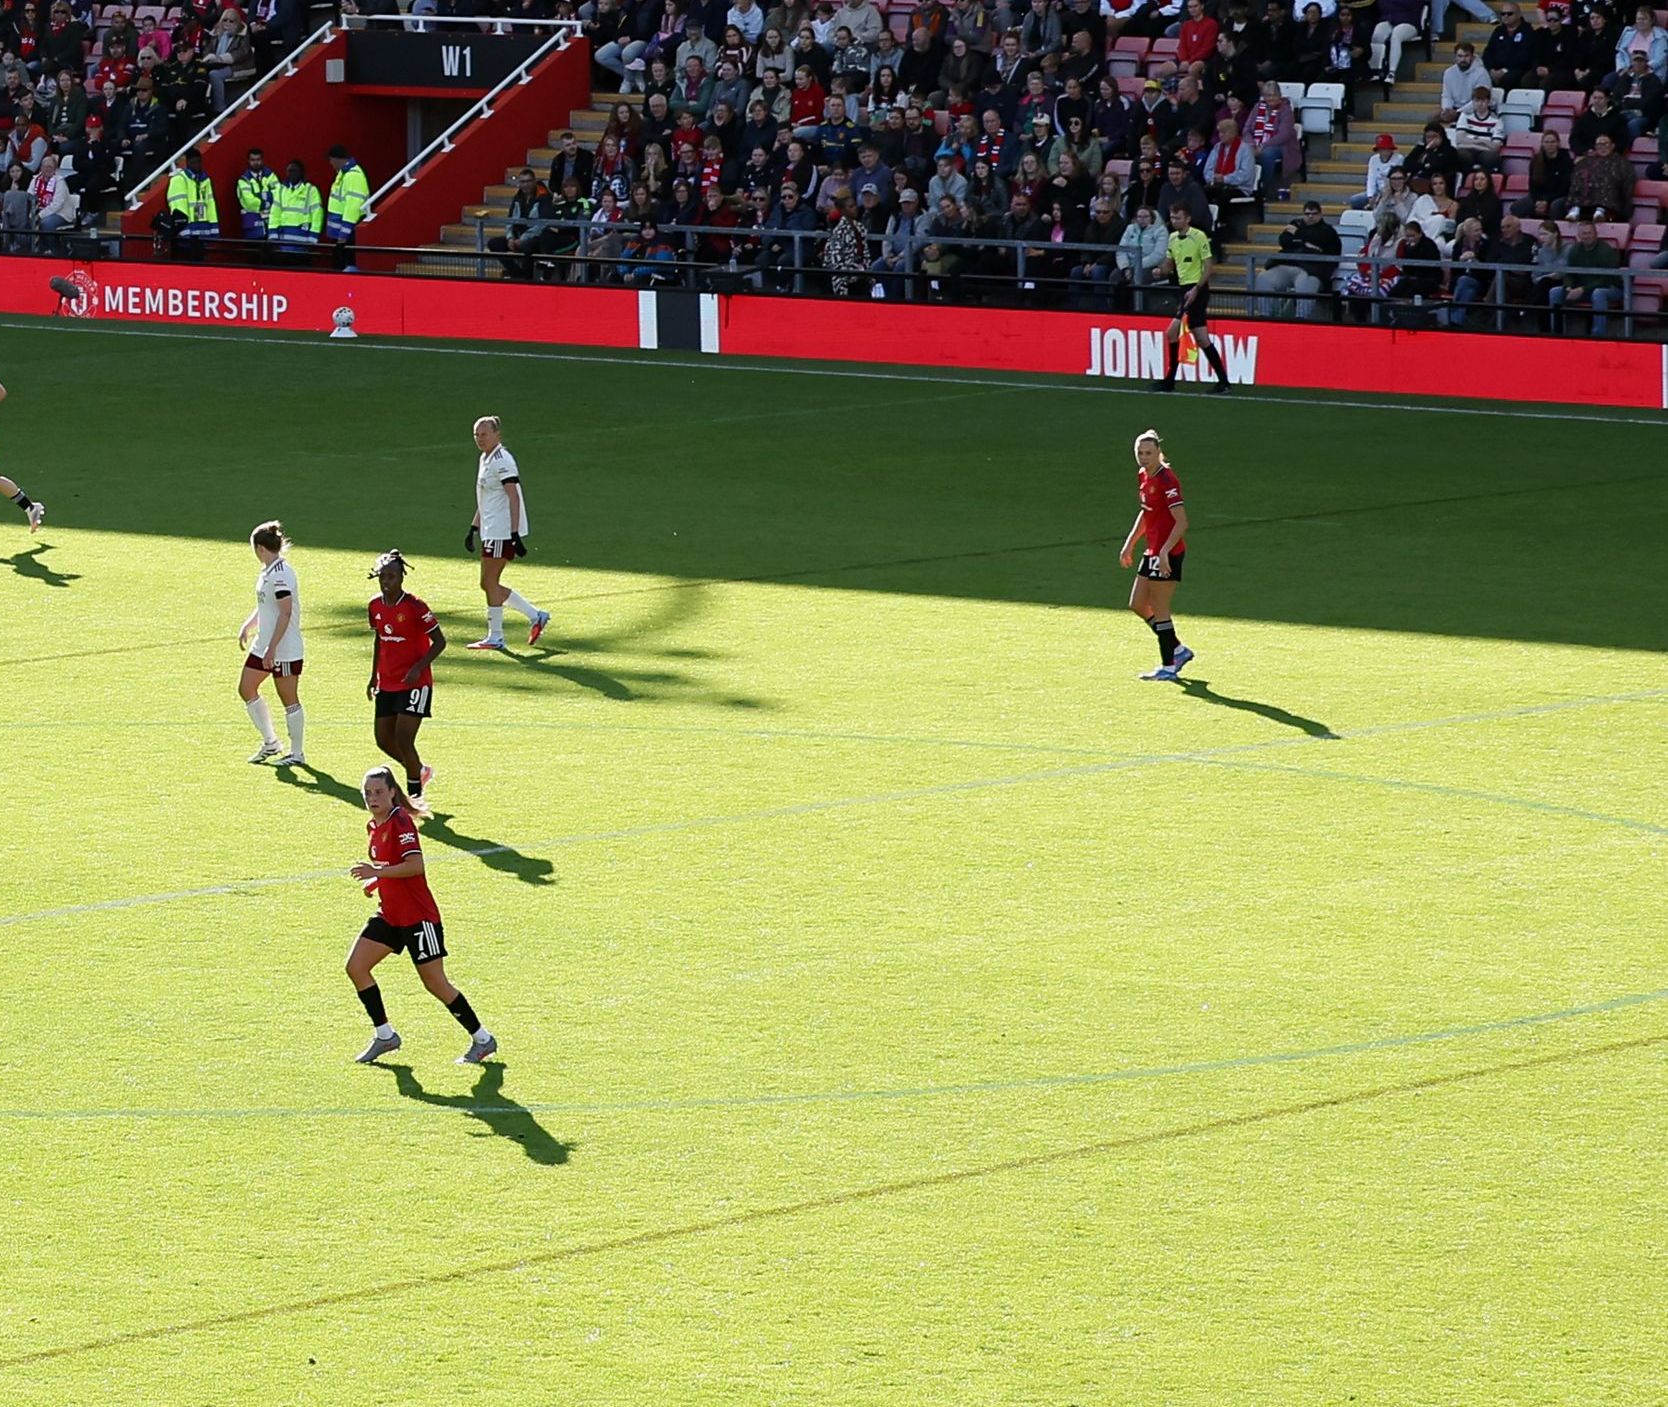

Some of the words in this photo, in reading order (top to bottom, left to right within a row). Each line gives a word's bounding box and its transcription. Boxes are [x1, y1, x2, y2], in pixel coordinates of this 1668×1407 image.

[441, 45, 471, 77] W1
[104, 285, 288, 322] MEMBERSHIP
[1085, 327, 1164, 380] JOIN
[409, 688, 420, 705] 9
[413, 931, 424, 952] 7
